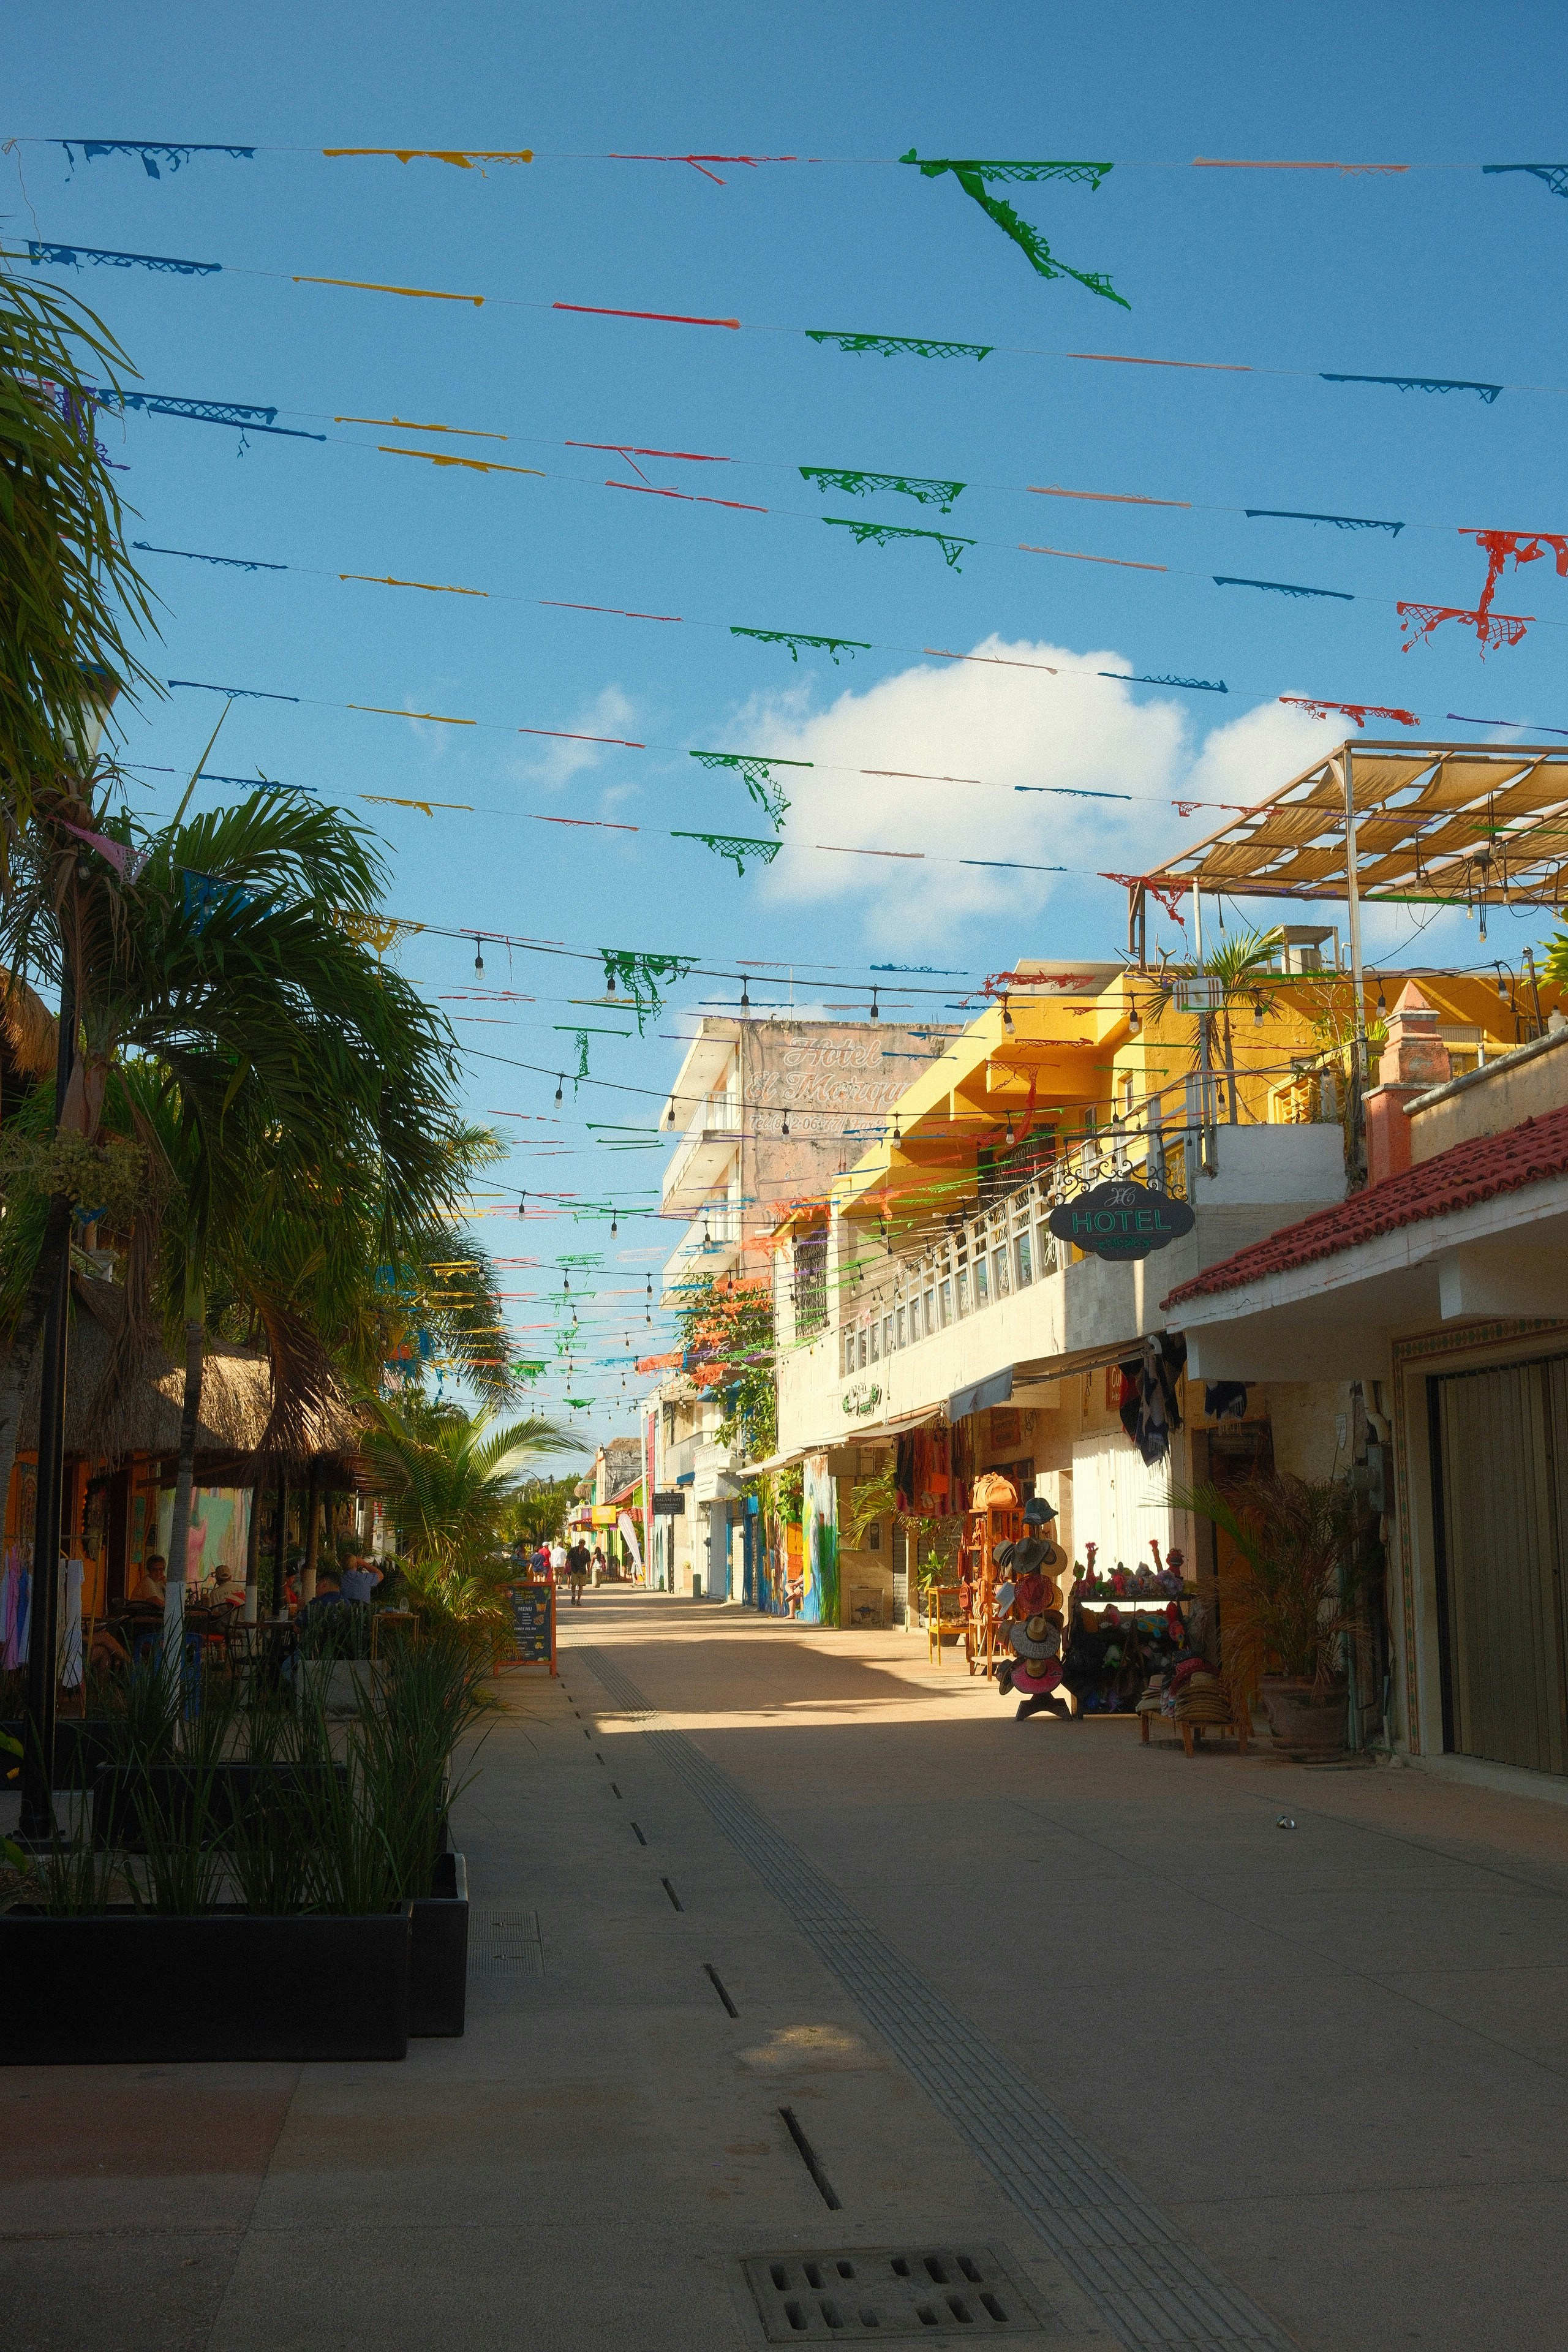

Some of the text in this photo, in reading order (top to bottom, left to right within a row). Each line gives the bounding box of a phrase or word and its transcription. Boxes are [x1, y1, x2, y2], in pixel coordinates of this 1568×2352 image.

[783, 1036, 883, 1069] Hotel
[745, 1071, 780, 1102] El
[1072, 1209, 1171, 1234] HOTEL
